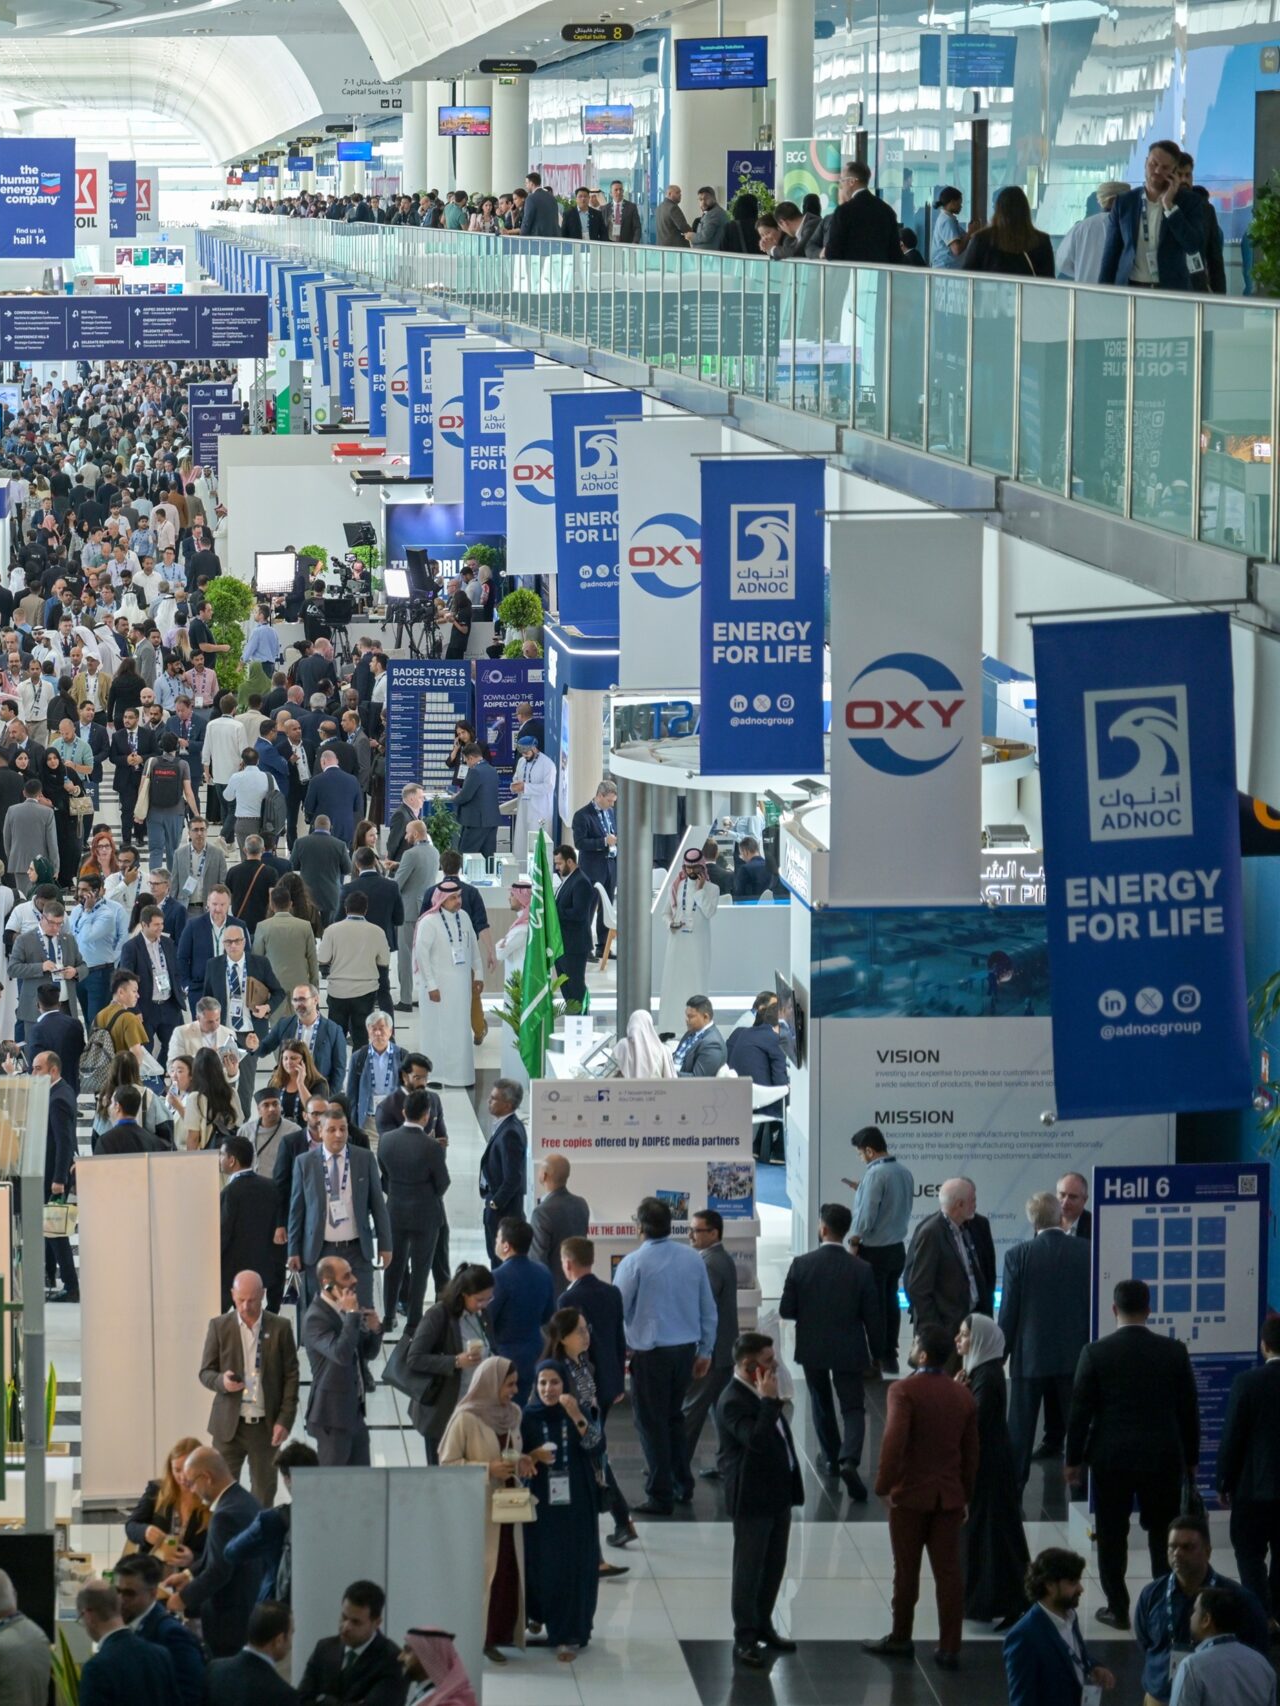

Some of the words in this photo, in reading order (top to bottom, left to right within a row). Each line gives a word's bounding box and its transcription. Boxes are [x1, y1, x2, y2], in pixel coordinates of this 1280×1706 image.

[613, 27, 623, 40] 8
[342, 88, 367, 96] Capital
[786, 152, 807, 163] BCG
[20, 165, 38, 175] the
[0, 175, 38, 184] human
[0, 185, 39, 195] energy
[6, 195, 58, 205] company
[14, 235, 33, 245] hall
[35, 236, 47, 245] 14
[439, 416, 464, 428] OX
[471, 459, 497, 470] FOR
[513, 465, 554, 480] OX
[581, 482, 618, 491] ADNOC
[566, 530, 599, 543] FOR
[737, 582, 789, 593] ADNOC
[713, 622, 811, 641] ENERGY
[713, 646, 759, 663] FOR
[765, 645, 811, 663] LIFE
[427, 669, 457, 677] TYPES
[459, 669, 466, 677] &
[392, 678, 430, 686] ACCESS
[432, 678, 466, 687] LEVELS
[845, 699, 966, 729] OXY
[730, 716, 794, 727] @adnocgroup
[1101, 809, 1182, 831] ADNOC
[1065, 869, 1222, 908] ENERGY
[1067, 913, 1139, 943] FOR
[1150, 906, 1224, 937] LIFE
[1100, 1019, 1202, 1040] @adnocgroup
[877, 1049, 940, 1064] VISION
[920, 1070, 952, 1079] expertise
[962, 1069, 989, 1079] provide
[940, 1081, 973, 1090] products,
[875, 1111, 954, 1124] MISSION
[921, 1130, 943, 1138] leader
[952, 1131, 967, 1140] pipe
[969, 1130, 1019, 1140] manufacturing
[1021, 1130, 1058, 1140] technology
[541, 1137, 561, 1148] Free
[563, 1136, 593, 1149] copies
[595, 1136, 627, 1147] offered
[629, 1137, 639, 1149] by
[642, 1136, 670, 1147] ADIPEC
[672, 1135, 699, 1147] media
[701, 1135, 740, 1149] partners
[899, 1143, 924, 1151] among
[925, 1141, 936, 1149] the
[938, 1141, 963, 1151] leading
[965, 1141, 1014, 1150] manufacturing
[1016, 1142, 1054, 1151] companies
[920, 1153, 943, 1161] aiming
[1104, 1177, 1149, 1199] Hall
[1156, 1177, 1170, 1198] 6
[601, 1226, 614, 1236] THE
